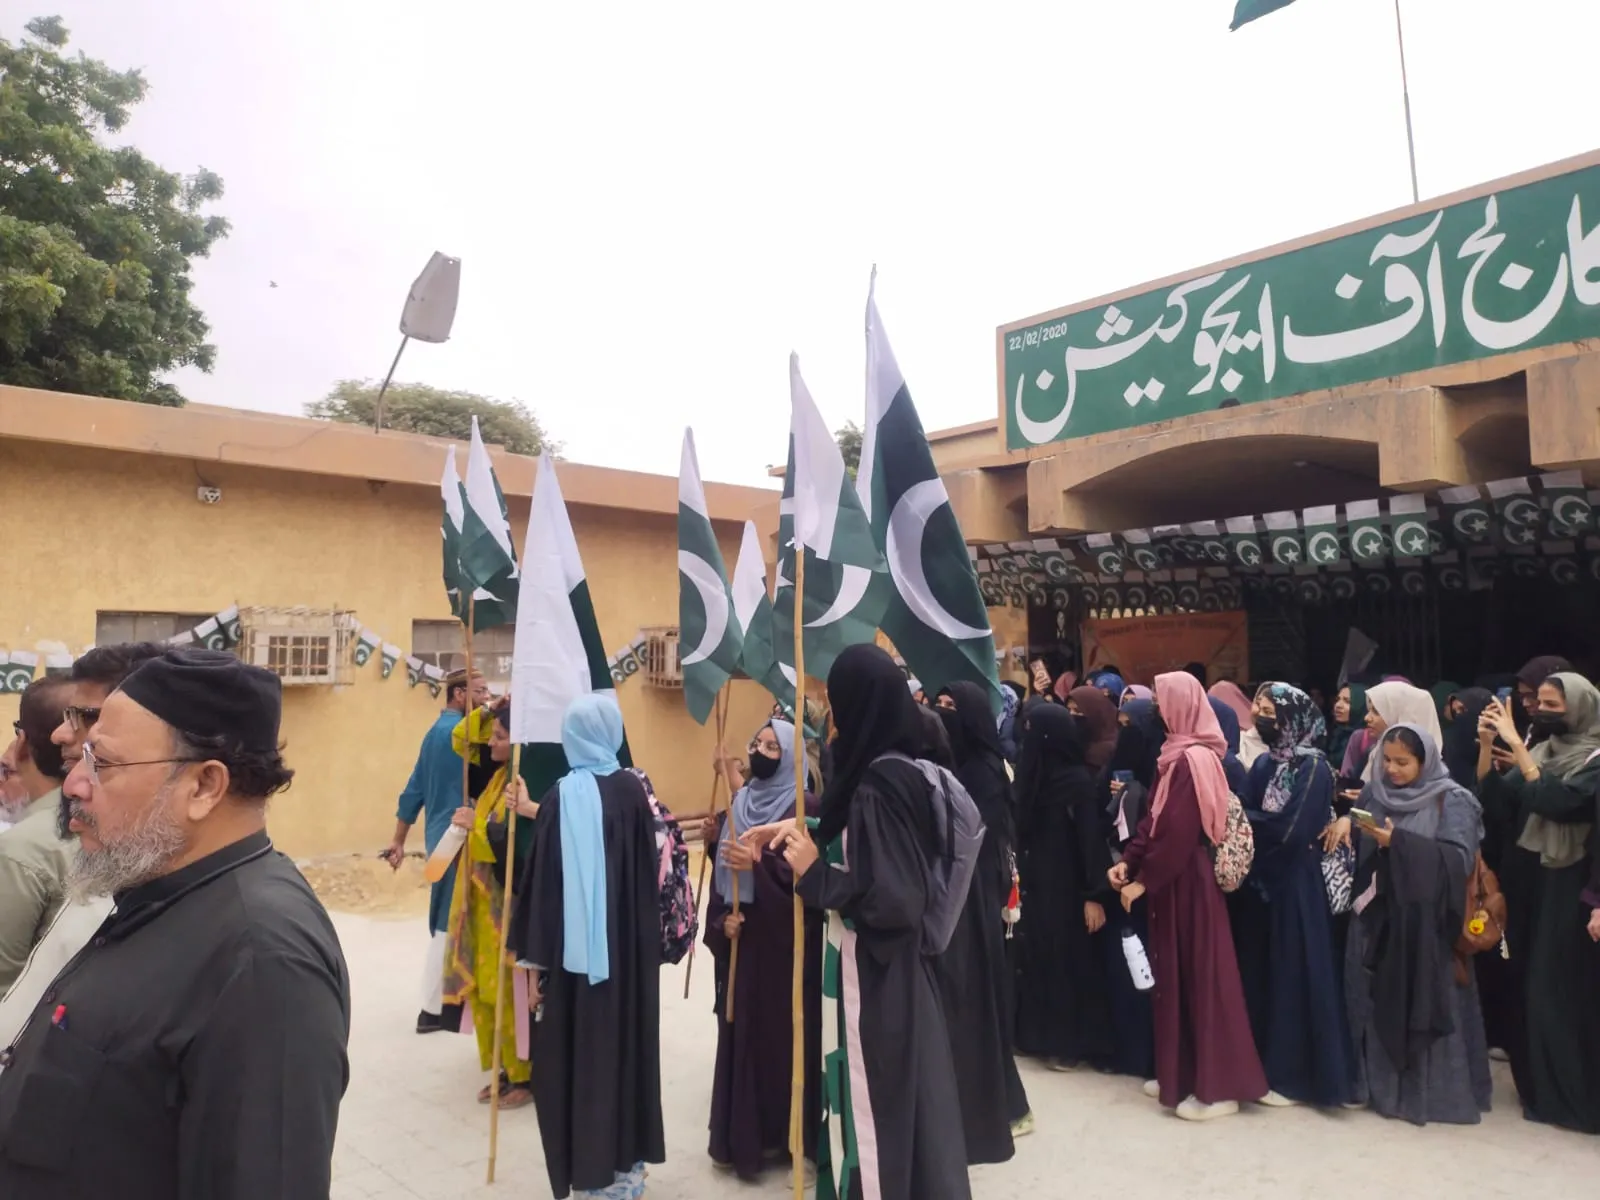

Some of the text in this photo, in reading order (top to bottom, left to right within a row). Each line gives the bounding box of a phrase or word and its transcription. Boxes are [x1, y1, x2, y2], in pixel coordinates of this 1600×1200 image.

[1009, 322, 1068, 352] 22/02/2020
[1015, 270, 1277, 444] ایجوکیشن
[1283, 209, 1443, 364] آف
